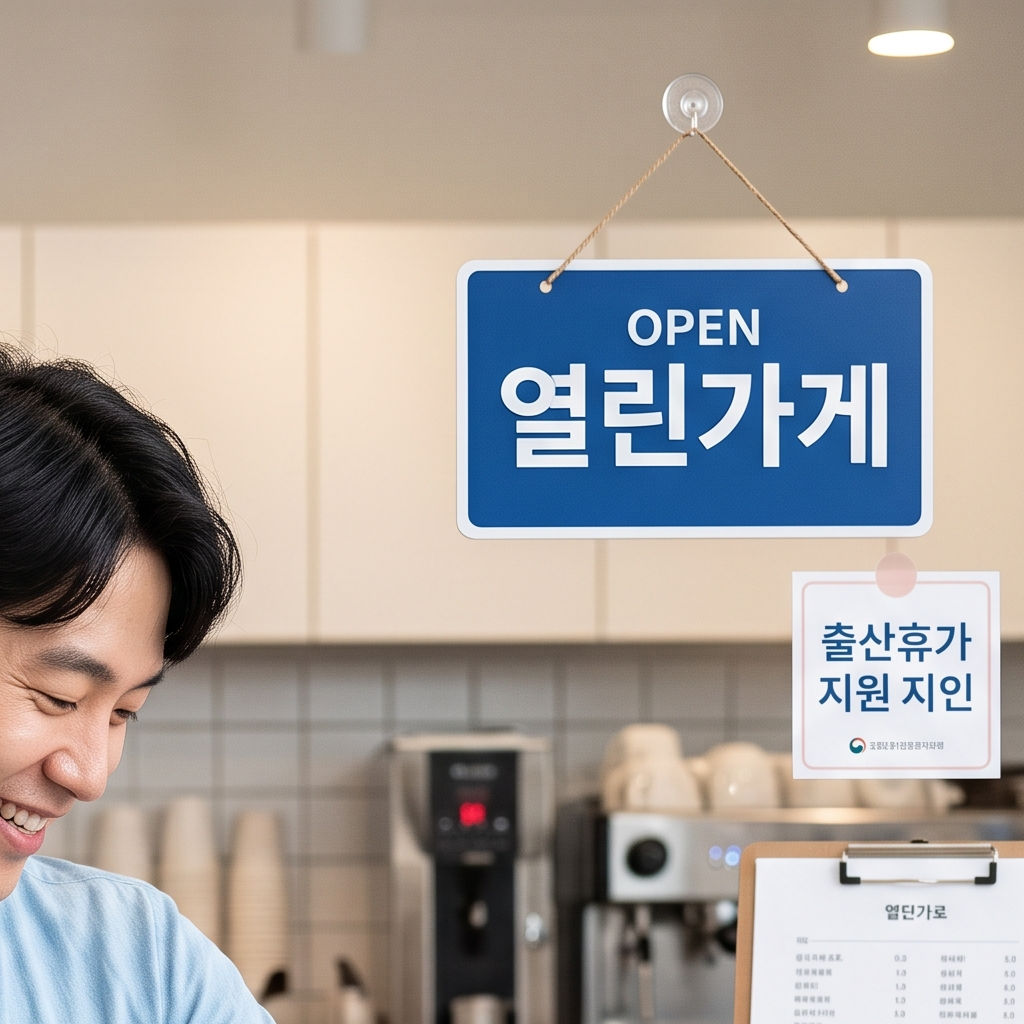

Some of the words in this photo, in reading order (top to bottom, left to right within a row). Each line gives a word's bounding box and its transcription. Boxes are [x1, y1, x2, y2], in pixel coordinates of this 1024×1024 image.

[627, 308, 760, 347] OPEN
[500, 362, 888, 468] 열린가게
[821, 621, 973, 663] 출산휴가
[818, 672, 890, 713] 지원
[901, 672, 973, 713] 지인
